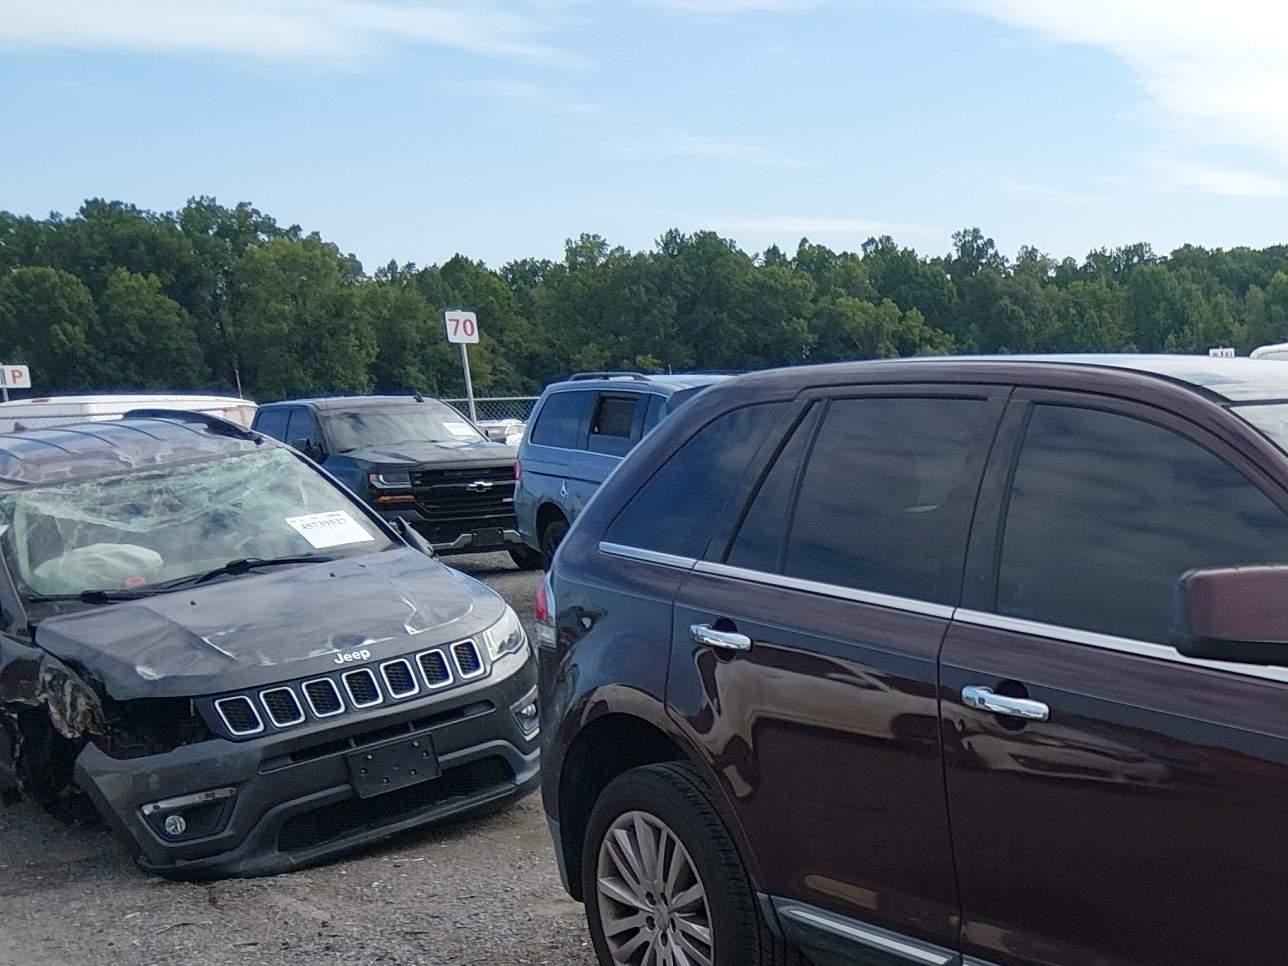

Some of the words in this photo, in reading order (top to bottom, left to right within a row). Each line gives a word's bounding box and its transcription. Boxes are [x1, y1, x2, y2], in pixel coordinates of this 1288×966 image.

[448, 318, 475, 337] 70
[11, 369, 23, 384] P
[334, 649, 371, 664] Jeep
